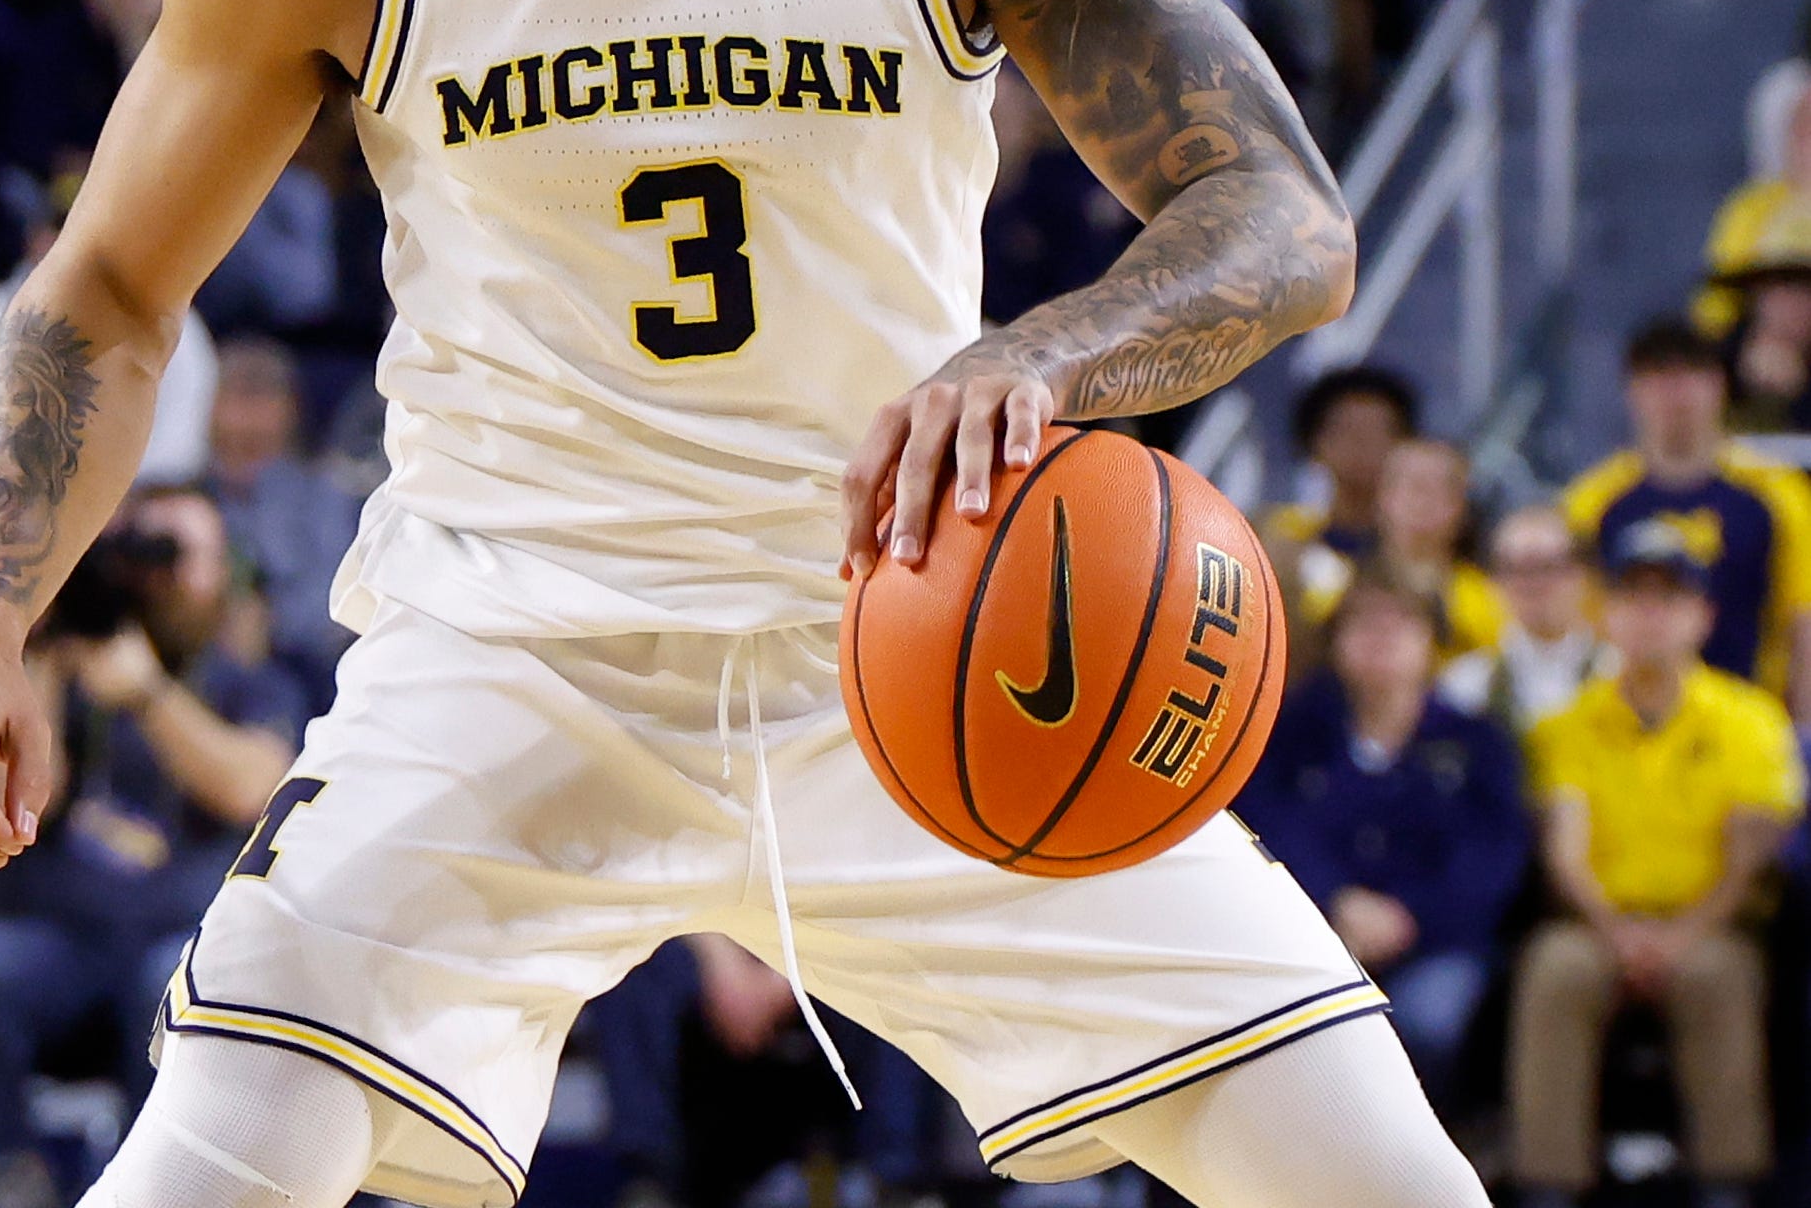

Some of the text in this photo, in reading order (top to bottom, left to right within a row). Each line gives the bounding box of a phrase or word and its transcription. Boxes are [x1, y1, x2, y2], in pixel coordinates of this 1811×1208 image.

[435, 34, 904, 149] MICHIGAN
[615, 155, 758, 365] 3
[1129, 541, 1244, 783] ELITE
